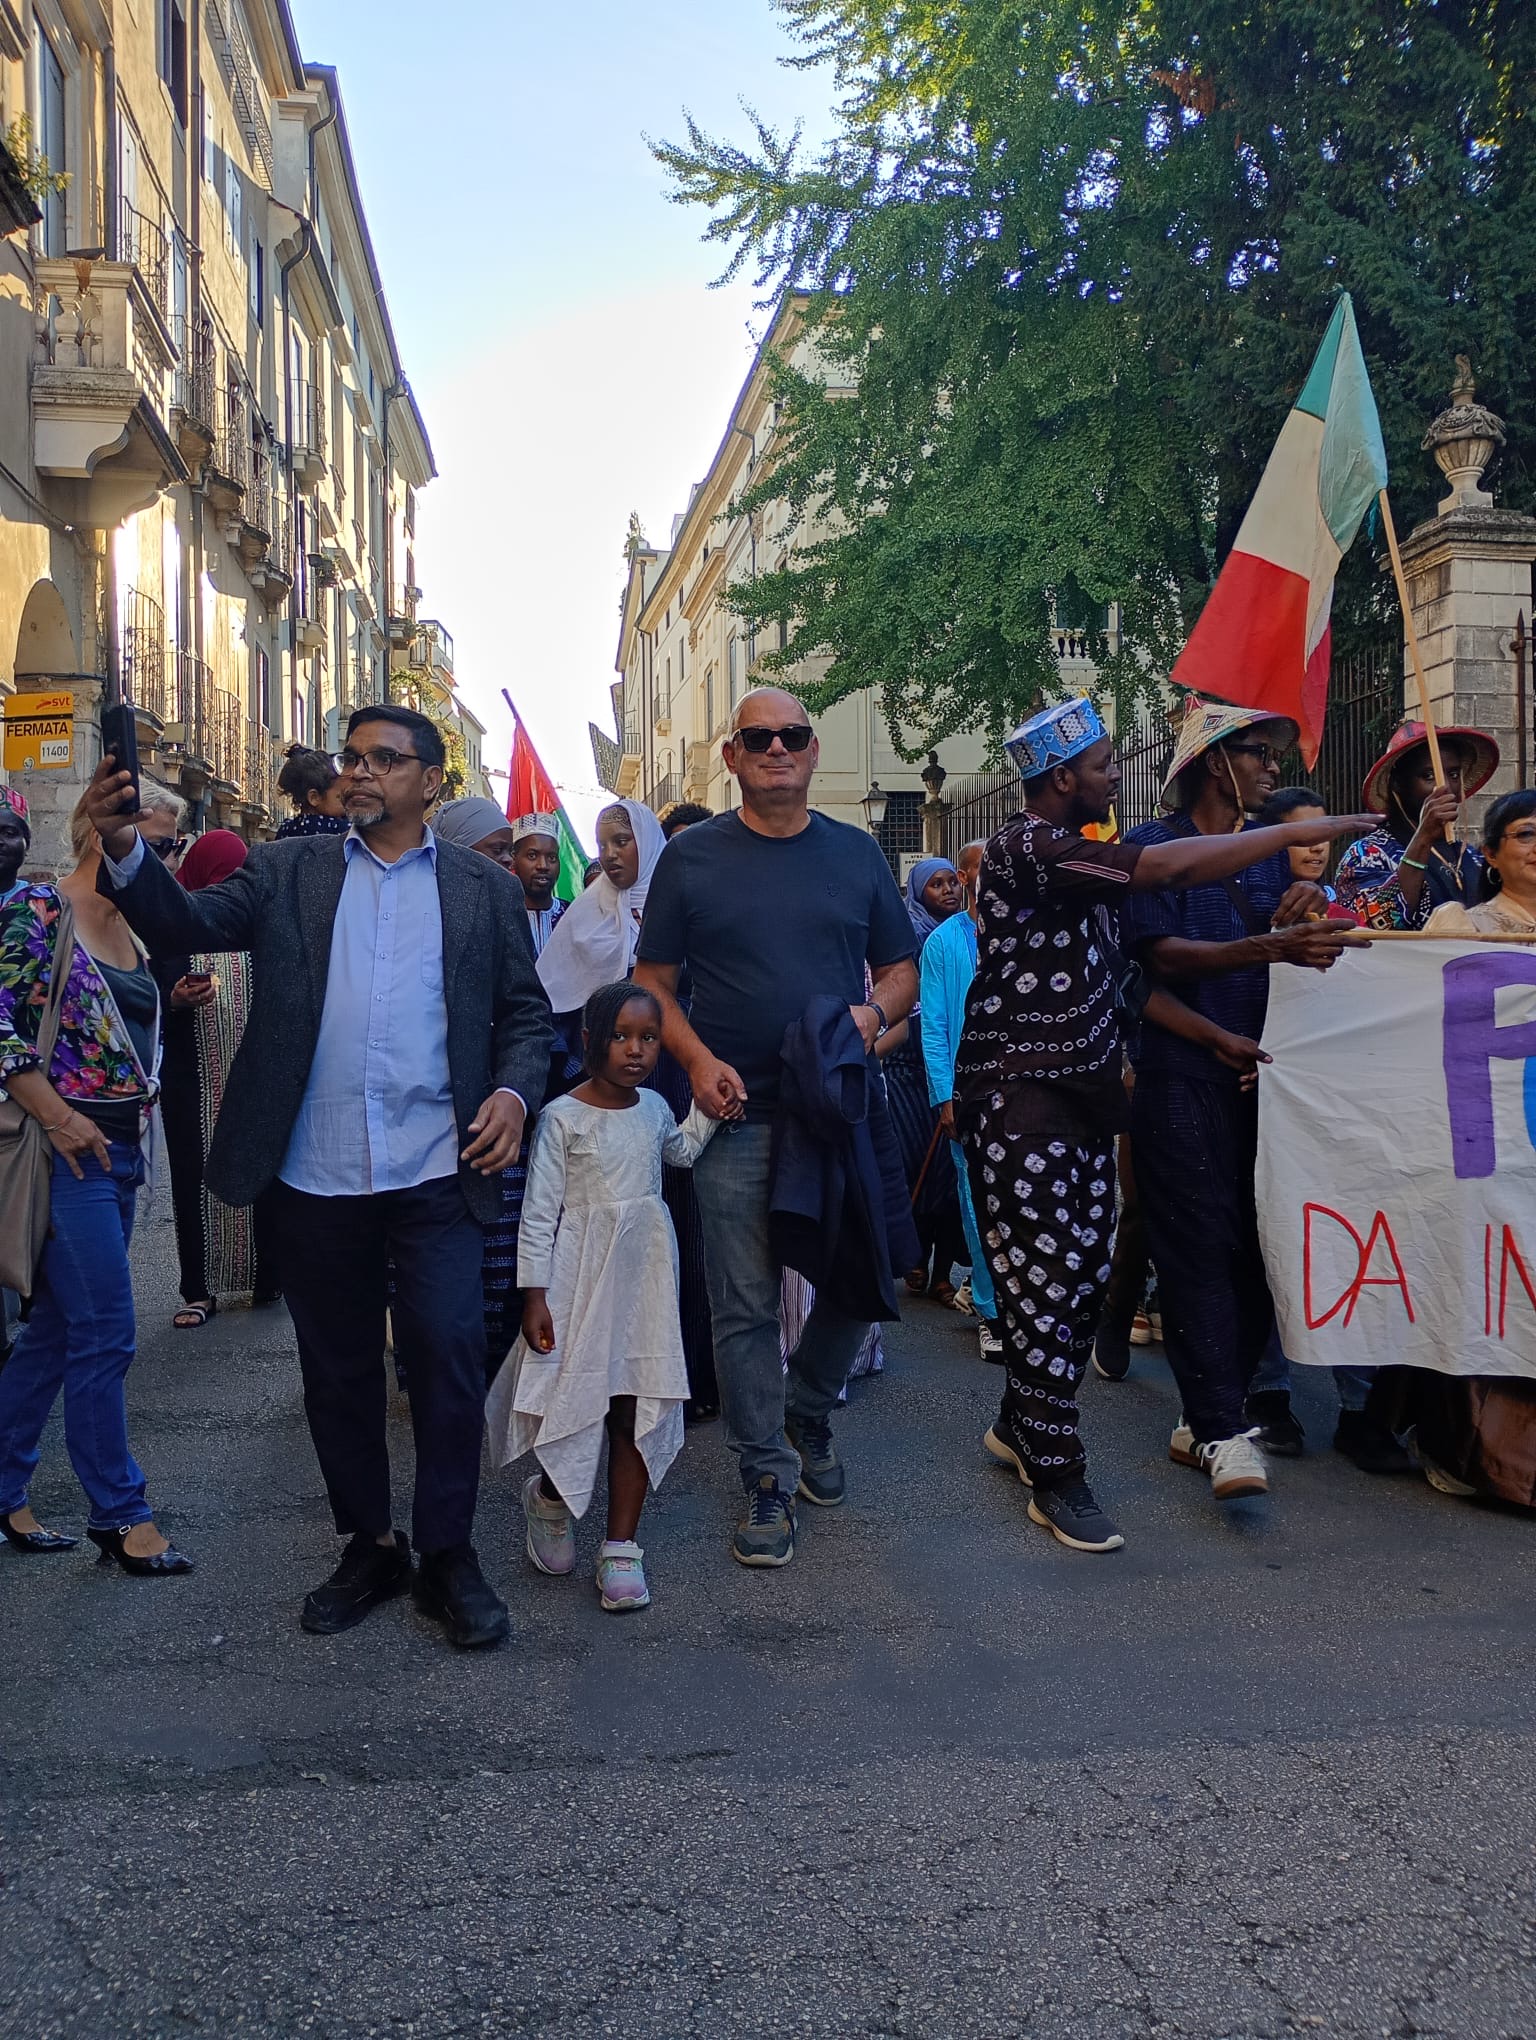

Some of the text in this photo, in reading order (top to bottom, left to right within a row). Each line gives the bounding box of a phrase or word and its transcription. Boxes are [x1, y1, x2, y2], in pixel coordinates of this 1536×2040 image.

[52, 695, 70, 706] svt
[6, 721, 69, 738] FERMATA
[42, 745, 69, 758] 11400
[1442, 951, 1536, 1178] P
[1303, 1202, 1415, 1330] DA
